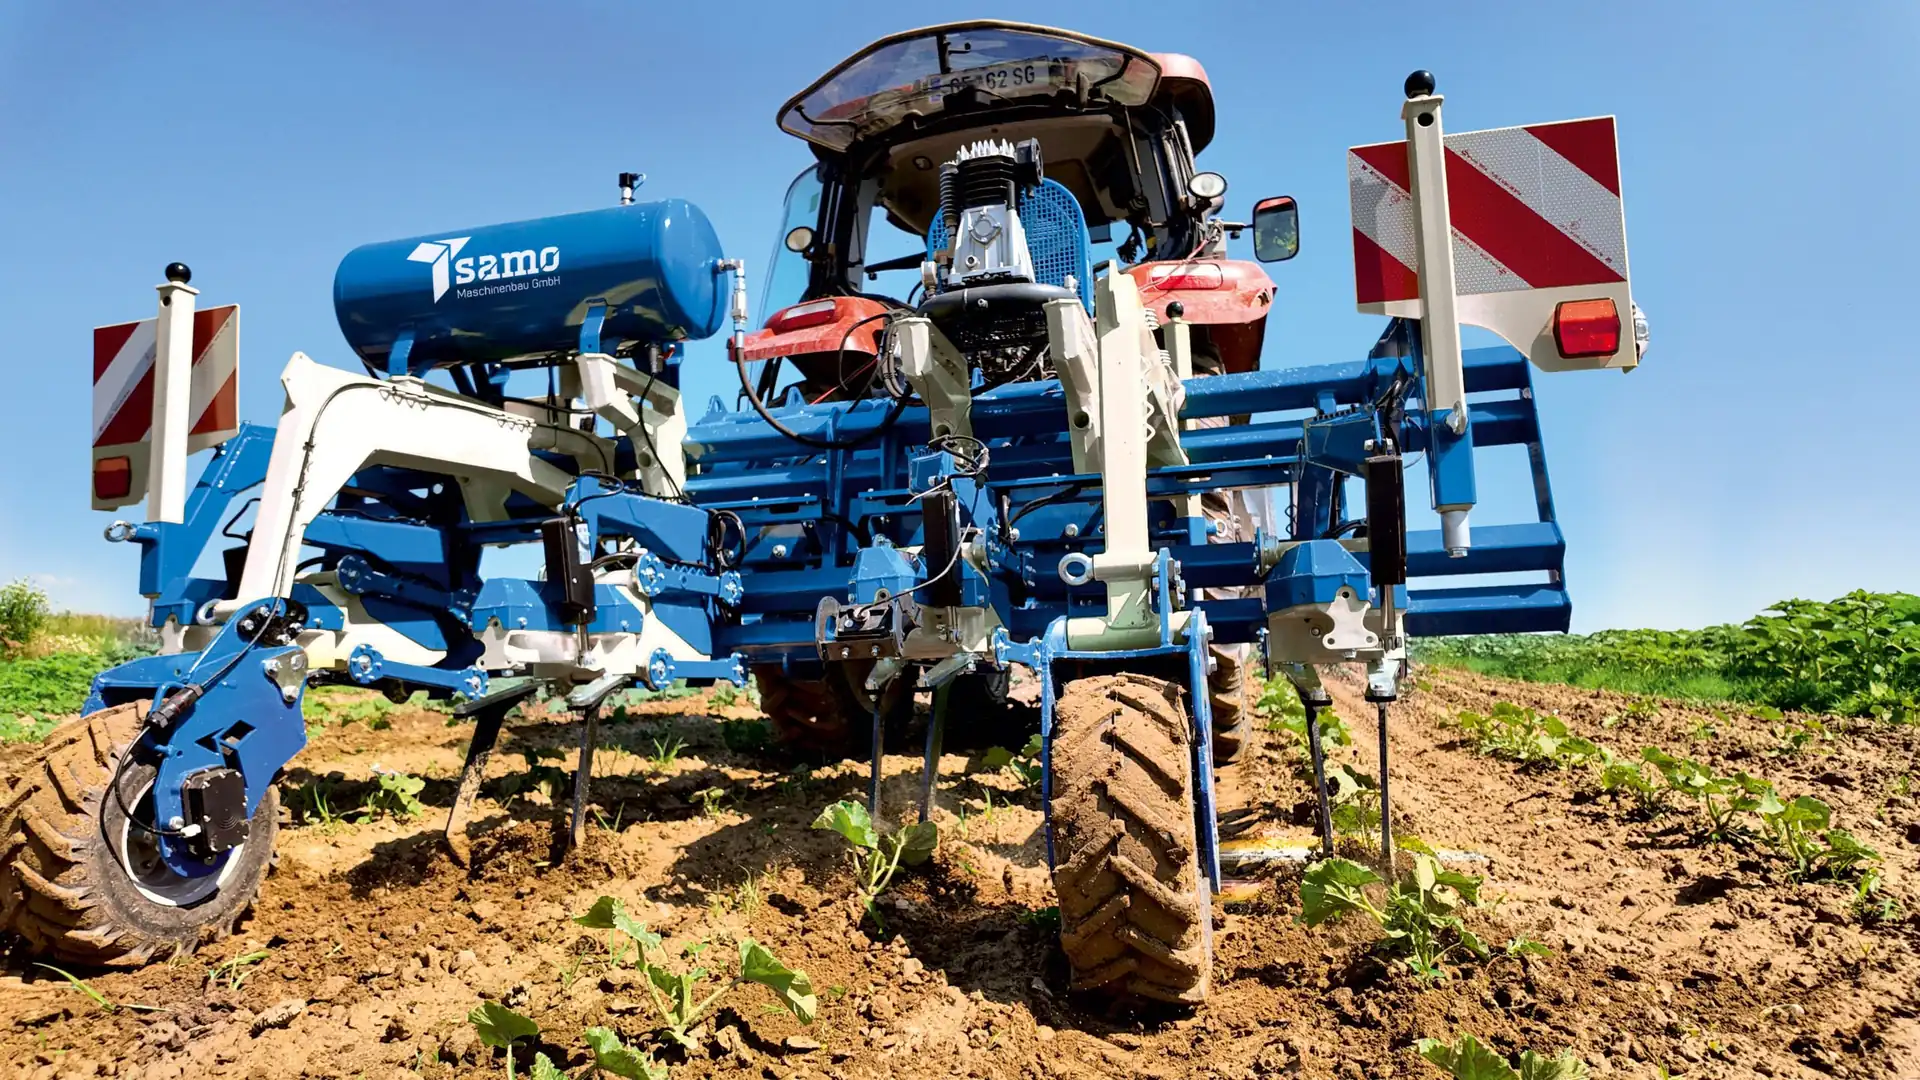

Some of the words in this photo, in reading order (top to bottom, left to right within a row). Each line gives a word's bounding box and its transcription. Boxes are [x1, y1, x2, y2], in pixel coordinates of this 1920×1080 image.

[1013, 65, 1035, 85] SG
[455, 246, 560, 285] samo
[456, 283, 529, 299] Maschinenbau
[532, 276, 561, 289] GmbH
